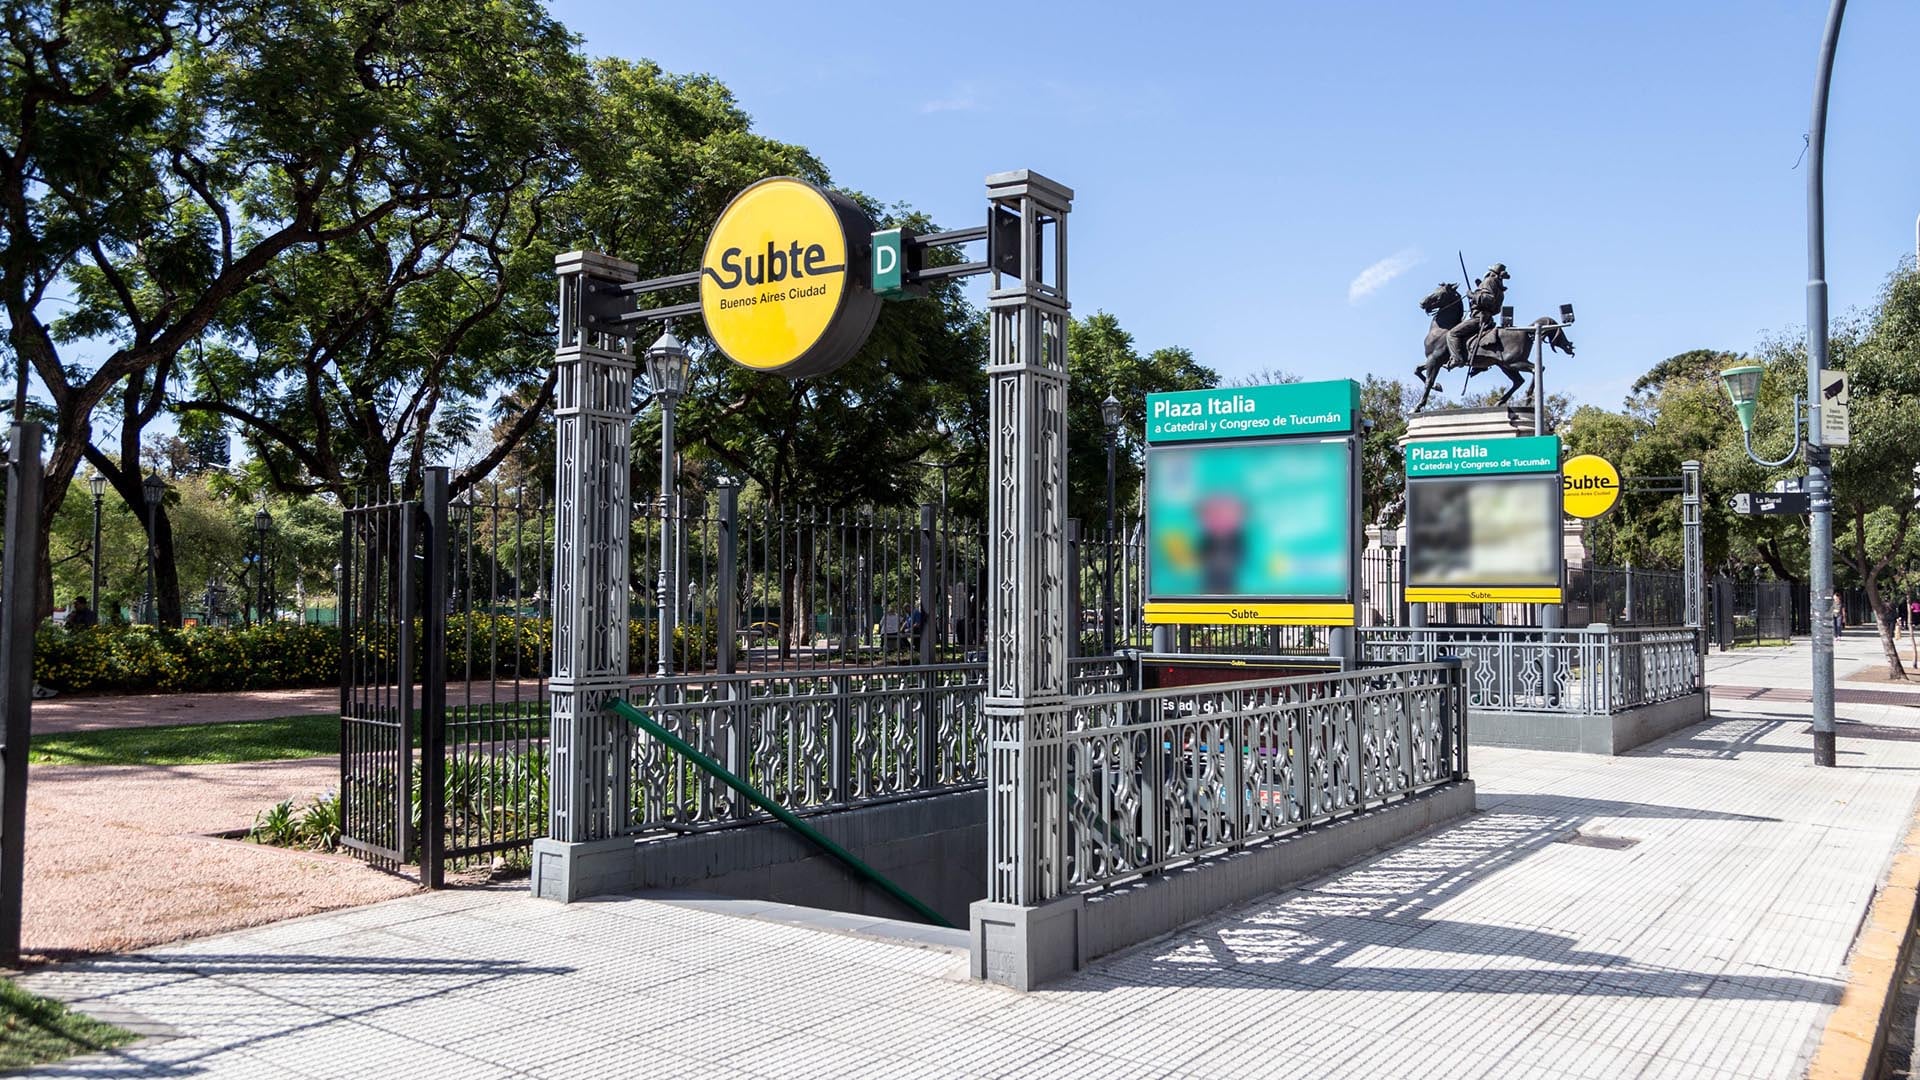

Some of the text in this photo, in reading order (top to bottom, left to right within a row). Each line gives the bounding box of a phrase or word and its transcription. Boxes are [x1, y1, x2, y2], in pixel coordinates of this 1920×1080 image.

[720, 240, 826, 290] Subte
[876, 245, 897, 275] D
[720, 284, 826, 310] Buenos Aires Ciudad
[1154, 395, 1255, 418] Plaza Italia
[1154, 411, 1341, 433] a Catedral y Congreso de Tucumán
[1412, 445, 1488, 460] Plaza Italia
[1419, 461, 1452, 471] Catedral
[1454, 463, 1459, 471] y
[1461, 460, 1499, 469] Congreso
[1500, 458, 1511, 468] de
[1513, 457, 1550, 467] Tucumán
[1563, 475, 1610, 489] Subte
[1471, 591, 1492, 599] Subte
[1231, 609, 1259, 619] Subte
